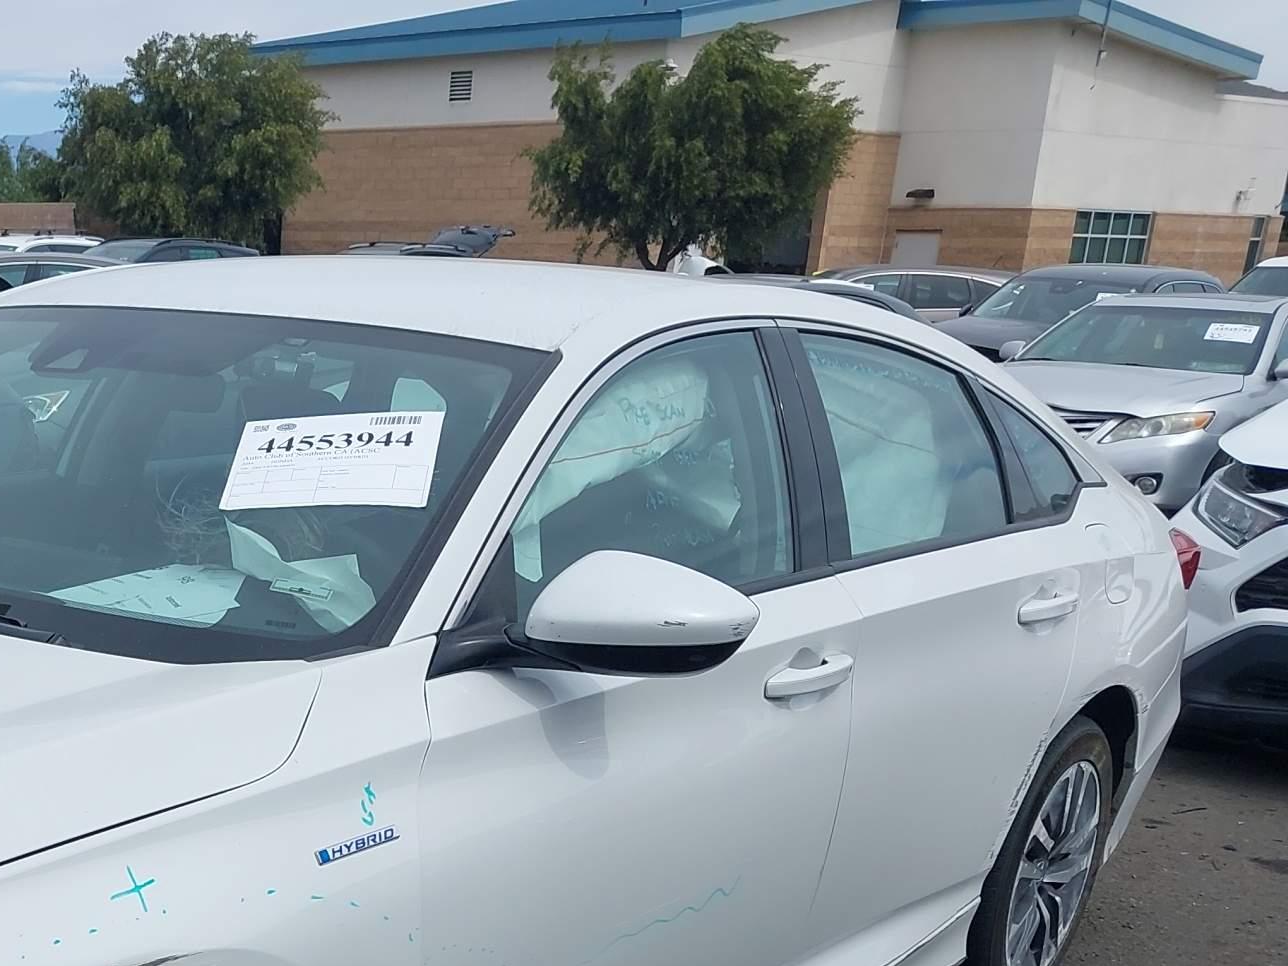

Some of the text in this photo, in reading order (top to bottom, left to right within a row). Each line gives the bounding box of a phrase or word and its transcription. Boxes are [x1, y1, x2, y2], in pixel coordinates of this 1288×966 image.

[258, 430, 414, 454] 44553944
[295, 449, 332, 458] Southern
[331, 828, 395, 859] HYBRID
